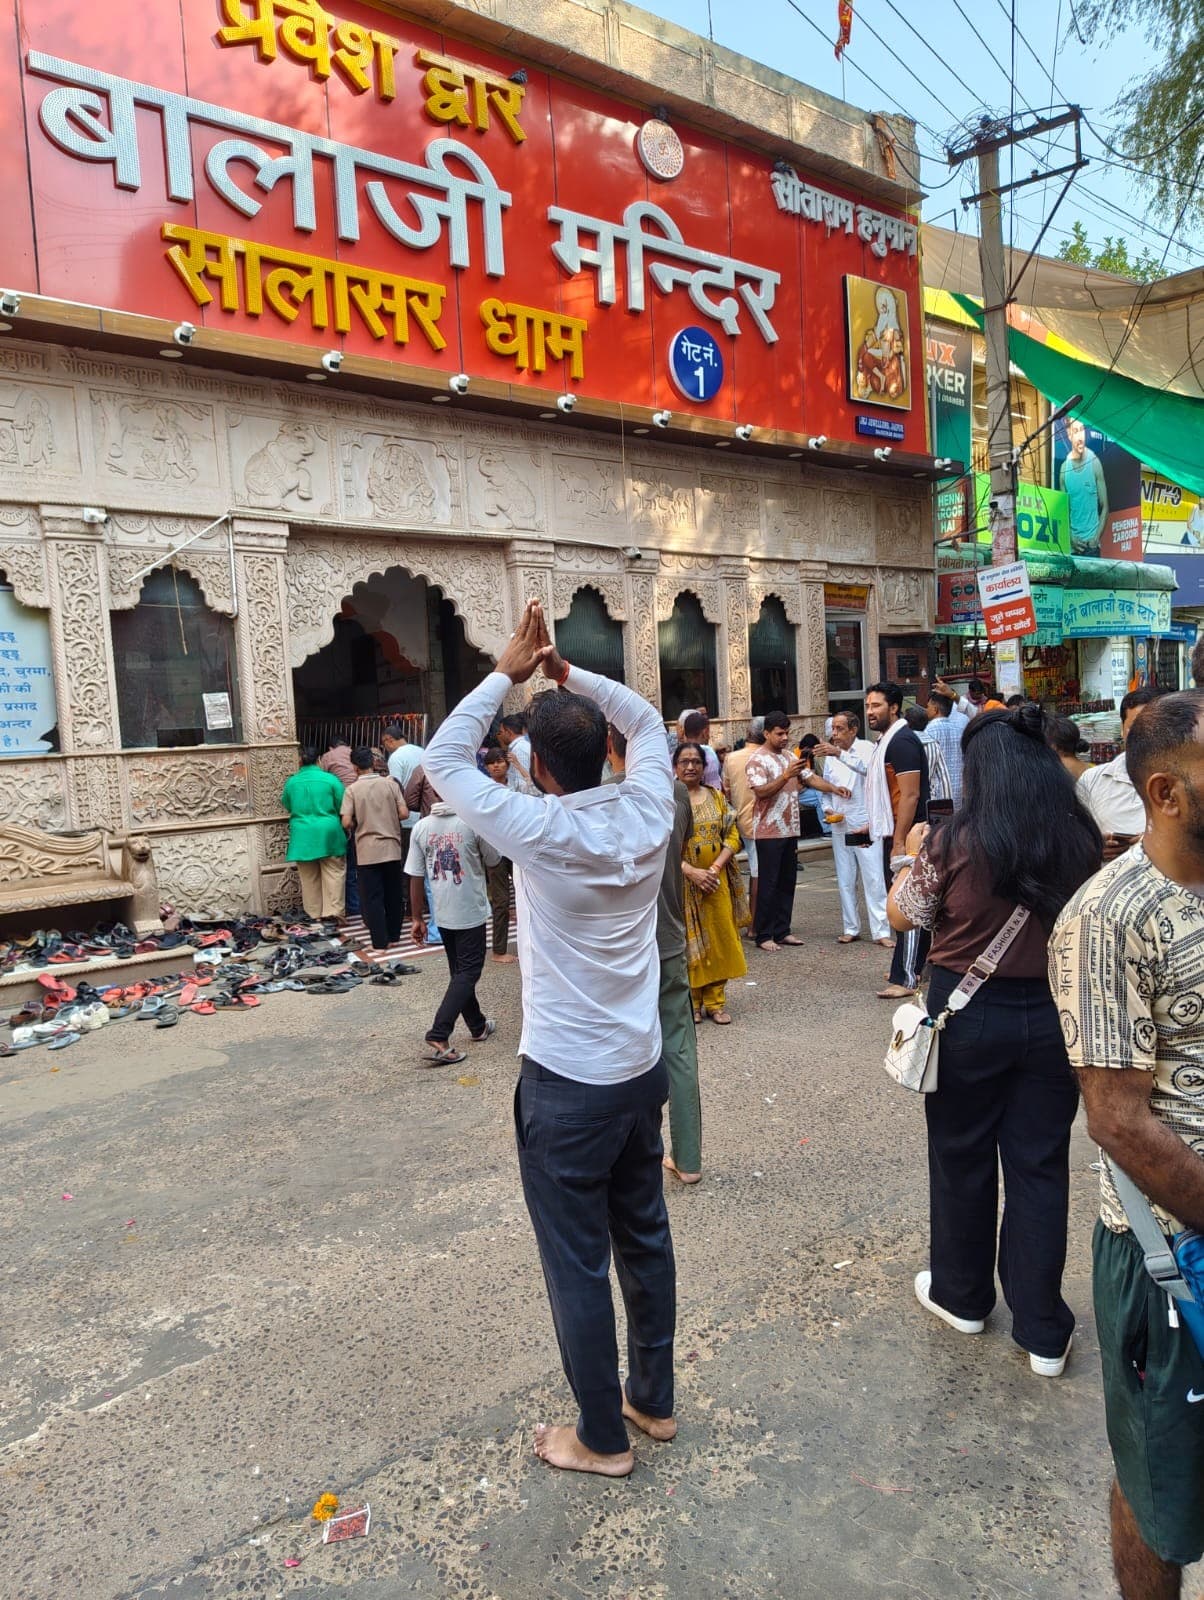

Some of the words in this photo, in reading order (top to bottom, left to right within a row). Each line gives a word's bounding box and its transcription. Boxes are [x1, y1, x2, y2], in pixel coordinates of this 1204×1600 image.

[416, 49, 527, 143] द्वार
[28, 50, 512, 277] बालाजी
[547, 201, 781, 343] मन्दिर
[770, 167, 855, 234] सीताराम
[856, 204, 918, 258] हनुमान
[162, 222, 446, 351] सालासर
[479, 297, 588, 381] धाम
[681, 335, 702, 363] गेट
[703, 342, 718, 368] नं.
[926, 337, 957, 367] UX
[694, 366, 704, 397] 1
[1017, 512, 1059, 544] OZI
[986, 576, 1022, 593] कार्यालय
[1064, 603, 1077, 627] श्री
[1079, 592, 1116, 618] बालाजी
[1117, 599, 1135, 620] बुक
[4, 702, 38, 712] प्रसाद
[0, 719, 32, 729] अन्दर
[987, 926, 1016, 960] FASHION
